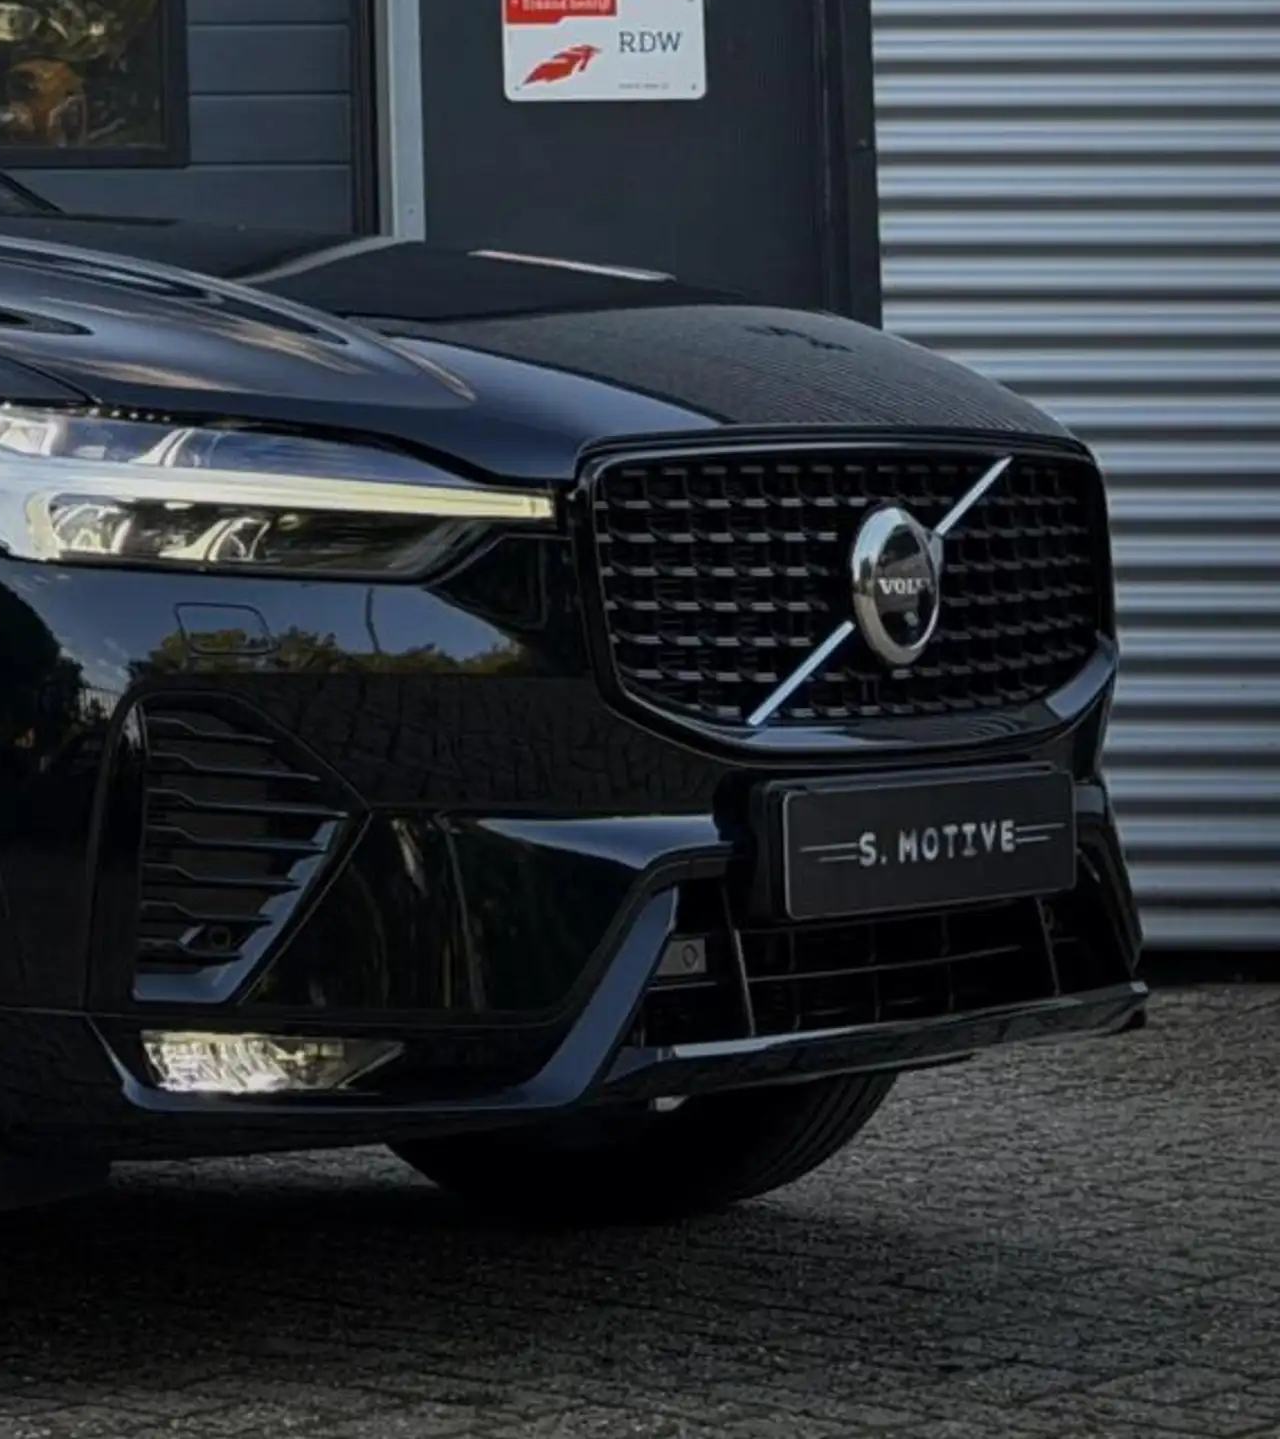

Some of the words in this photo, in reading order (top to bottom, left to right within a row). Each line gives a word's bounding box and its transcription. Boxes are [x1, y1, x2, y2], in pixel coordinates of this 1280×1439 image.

[618, 31, 682, 53] RDW
[858, 831, 888, 866] S.
[898, 819, 1016, 864] MOTIVE
